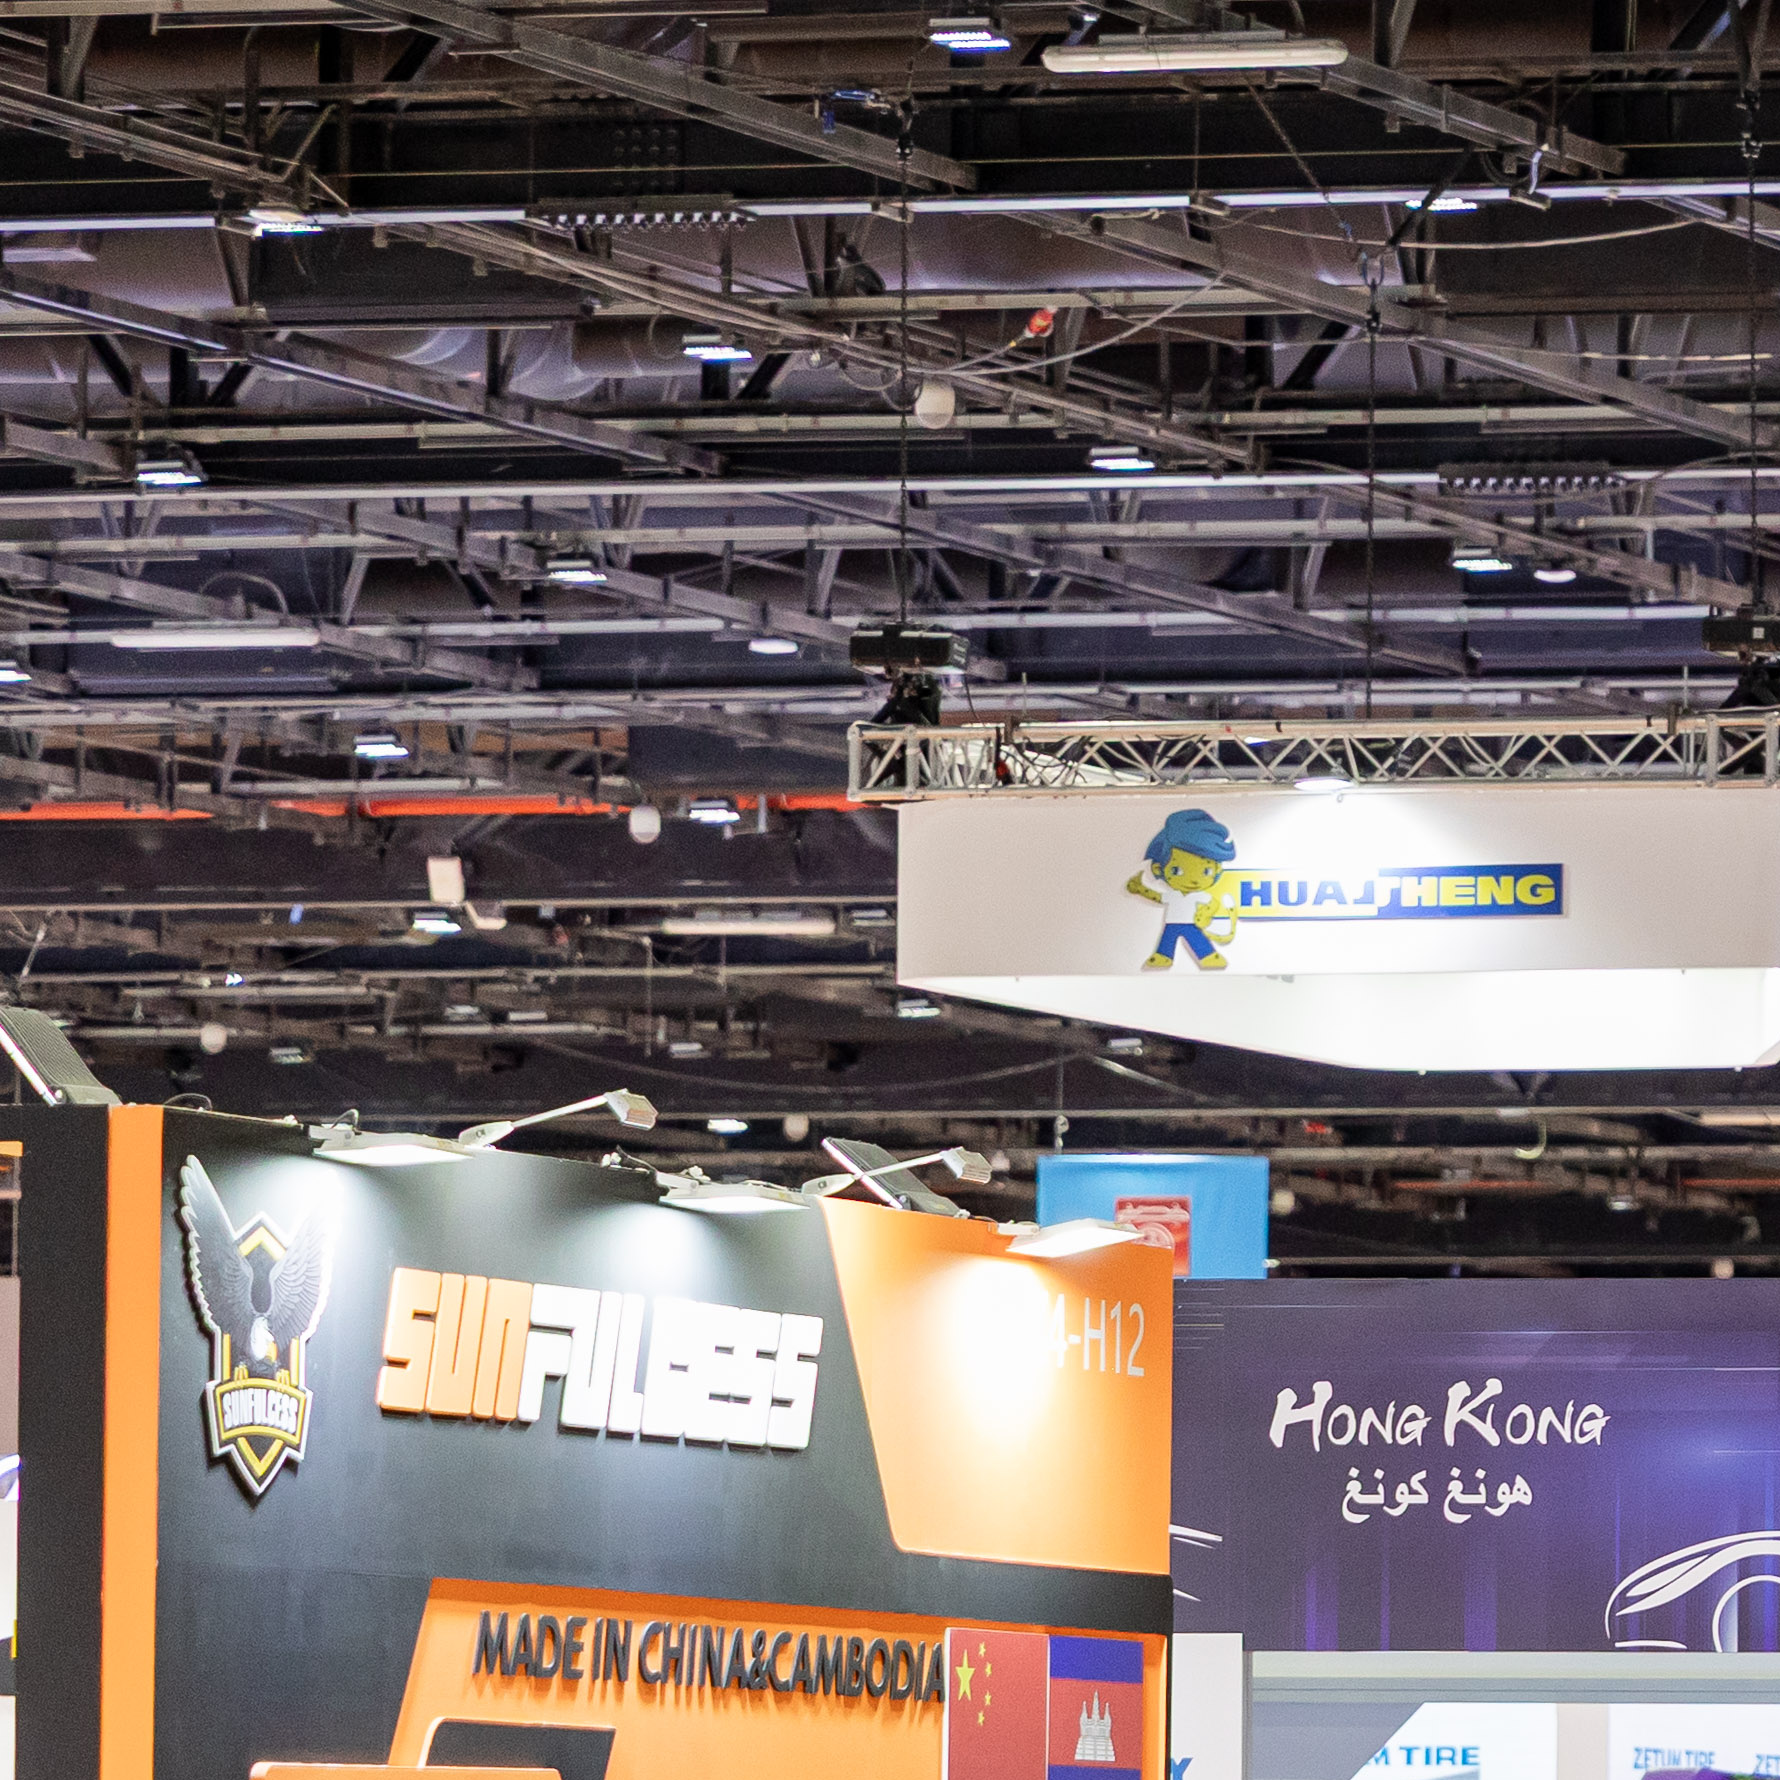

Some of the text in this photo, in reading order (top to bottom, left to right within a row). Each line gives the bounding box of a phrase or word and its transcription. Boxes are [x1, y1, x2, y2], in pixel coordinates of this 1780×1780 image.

[1269, 1378, 1612, 1453] HONG KONG
[1341, 1467, 1534, 1523] هونغ كونغ
[473, 1610, 947, 1703] MADE IN CHINA&CAMBODIA
[1399, 1746, 1480, 1766] TIRE
